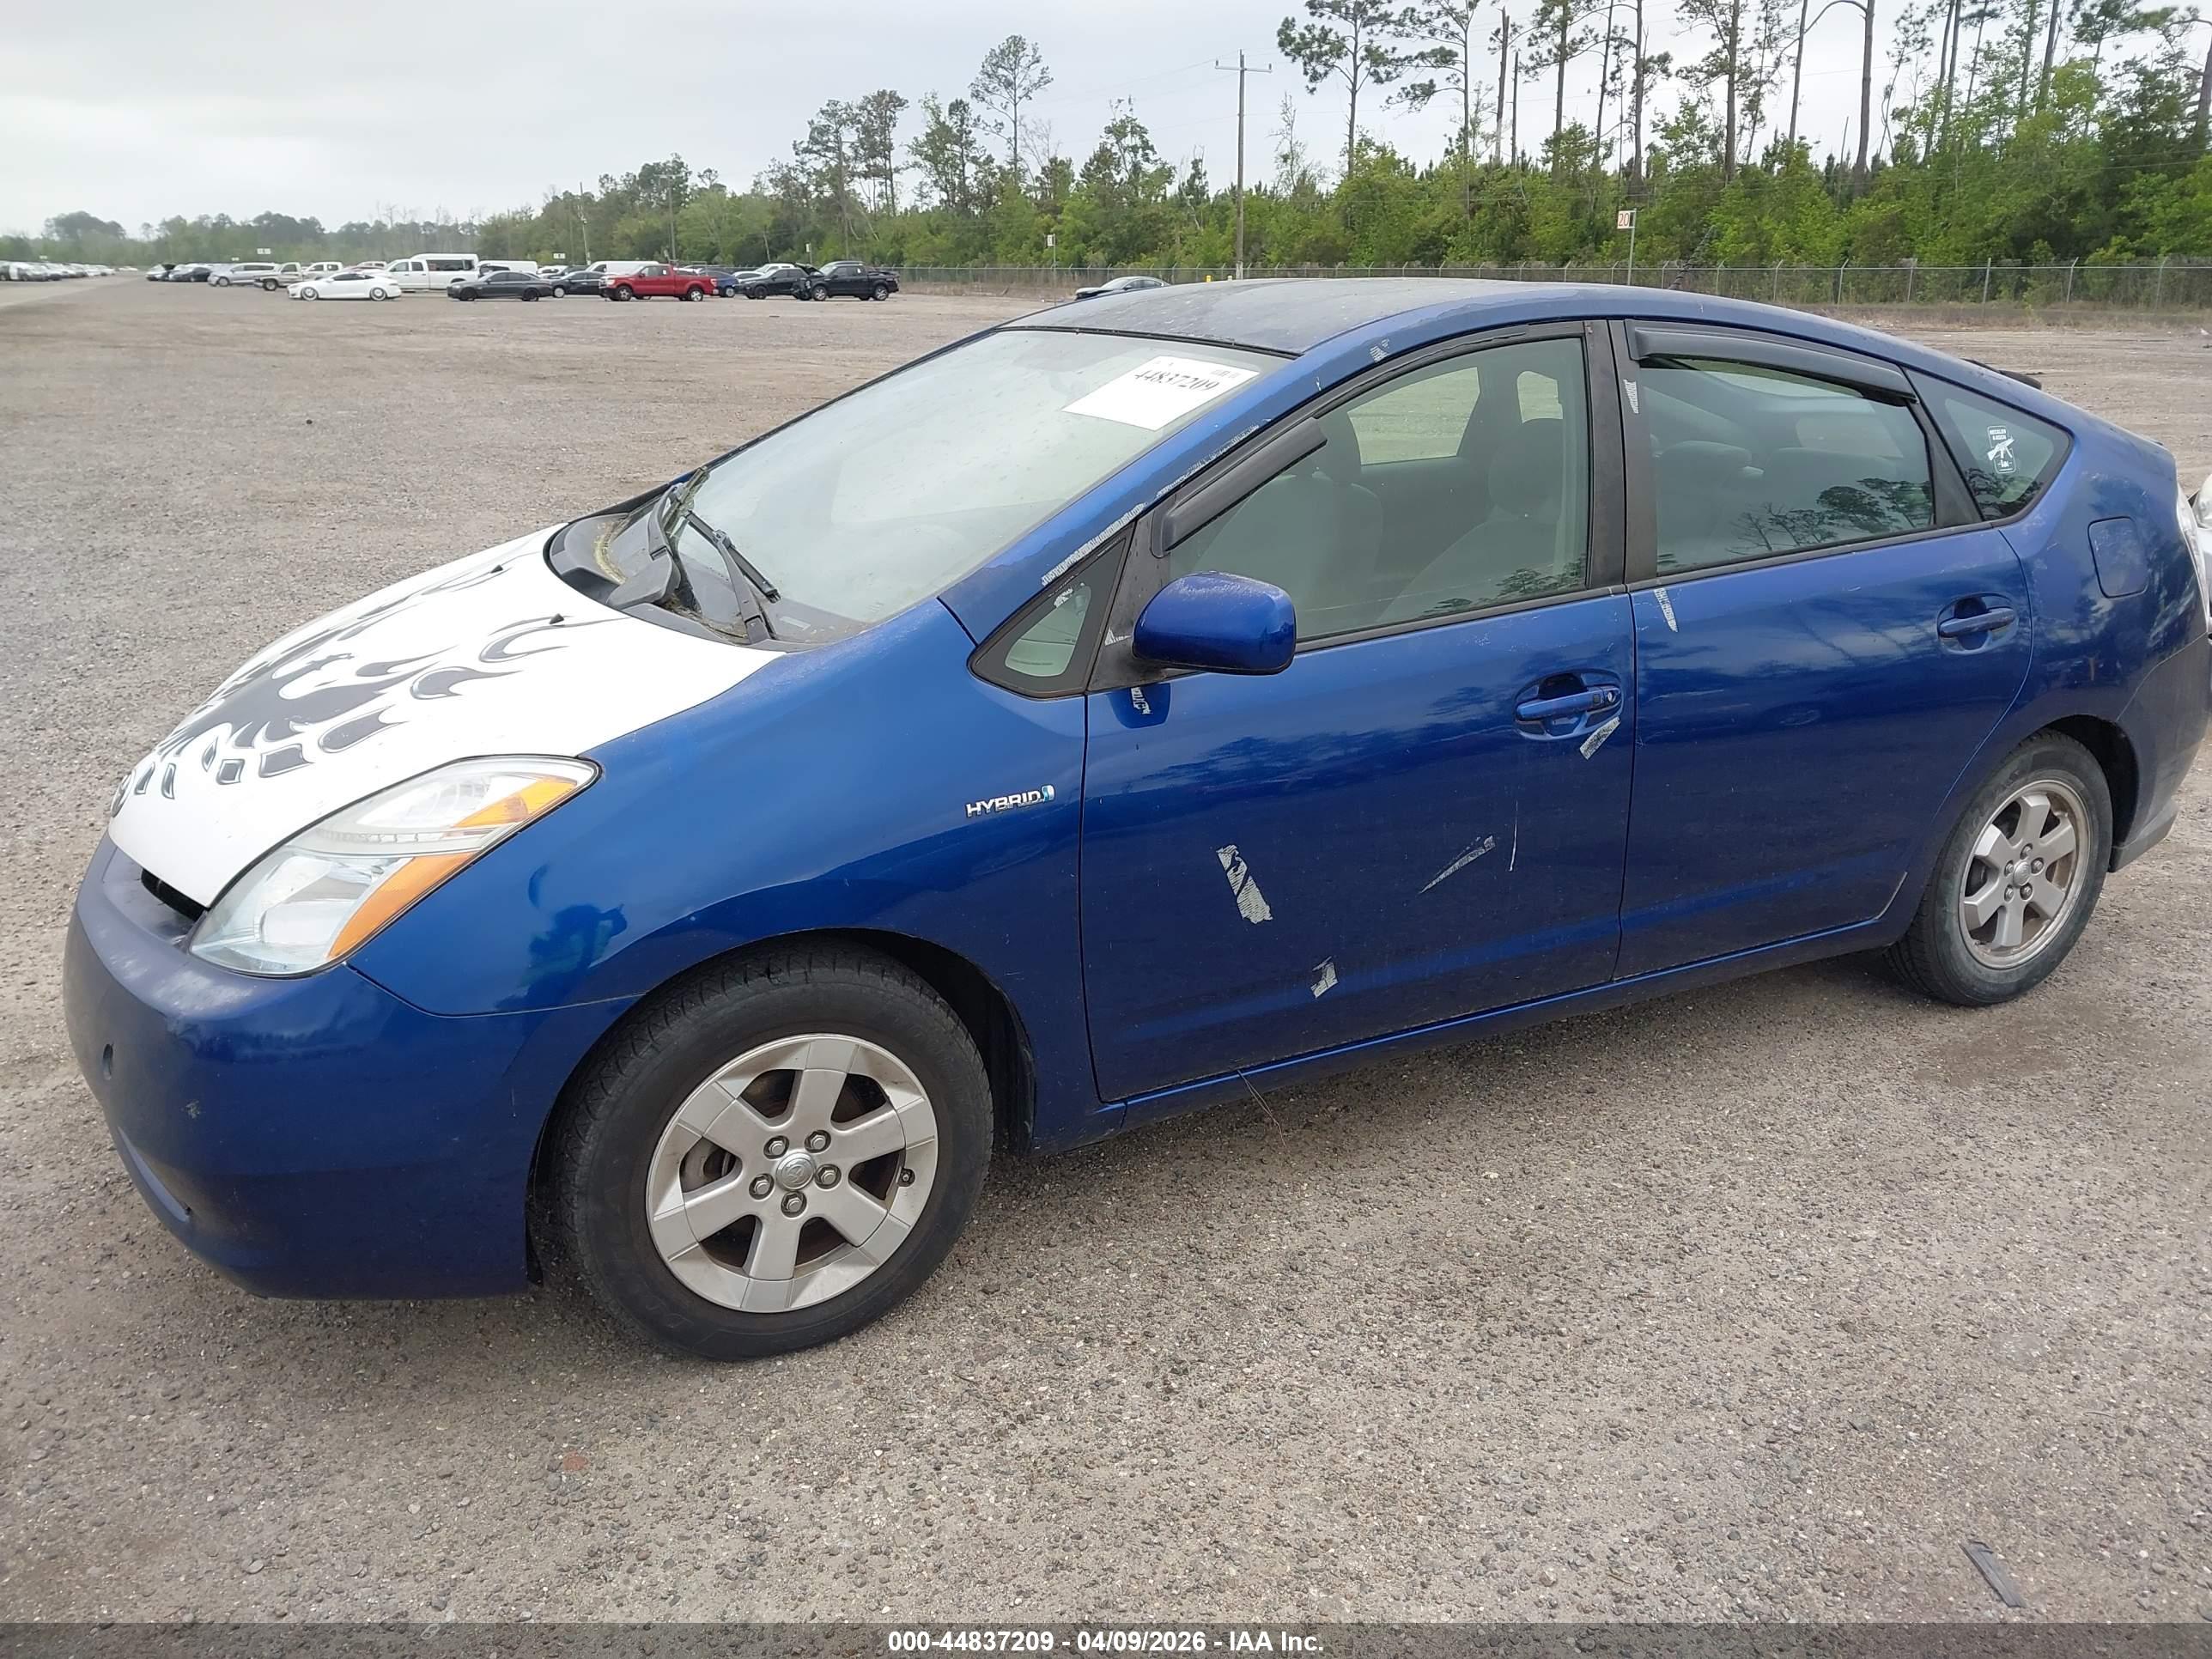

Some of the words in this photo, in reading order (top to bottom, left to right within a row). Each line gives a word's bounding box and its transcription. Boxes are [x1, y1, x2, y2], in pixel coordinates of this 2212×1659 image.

[1618, 213, 1629, 227] 20
[1134, 370, 1220, 391] 44837209
[966, 790, 1042, 817] HYBRID
